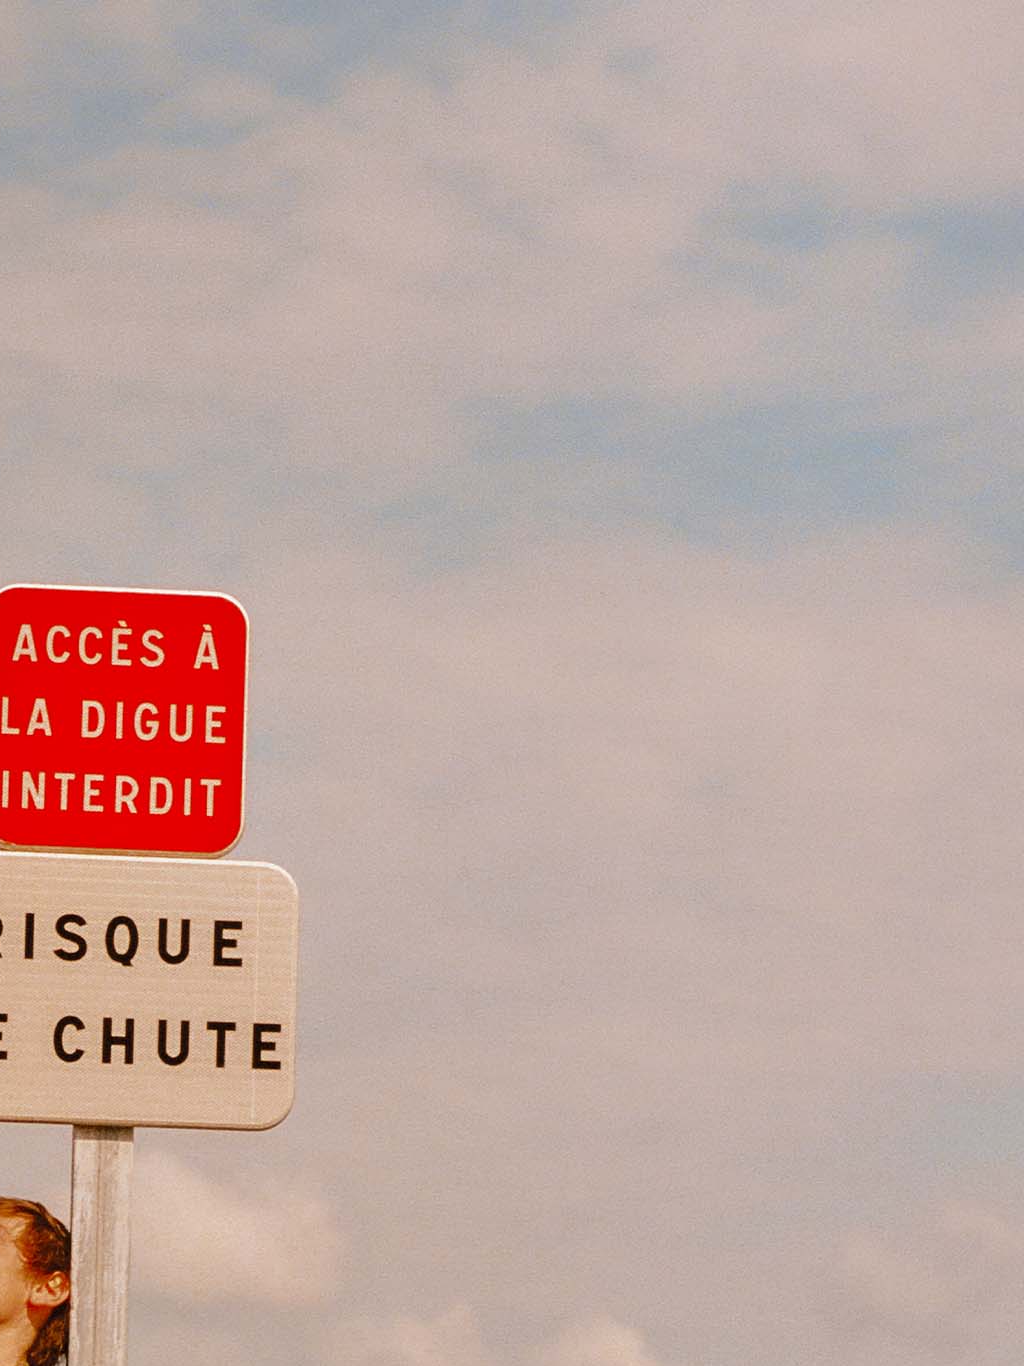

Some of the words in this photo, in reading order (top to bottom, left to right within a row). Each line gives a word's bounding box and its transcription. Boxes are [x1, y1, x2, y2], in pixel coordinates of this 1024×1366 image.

[13, 621, 164, 667] ACCÈS
[194, 624, 219, 669] À
[1, 697, 51, 736] LA
[82, 701, 226, 743] DIGUE
[2, 771, 221, 816] INTERDIT
[53, 1016, 281, 1070] CHUTE
